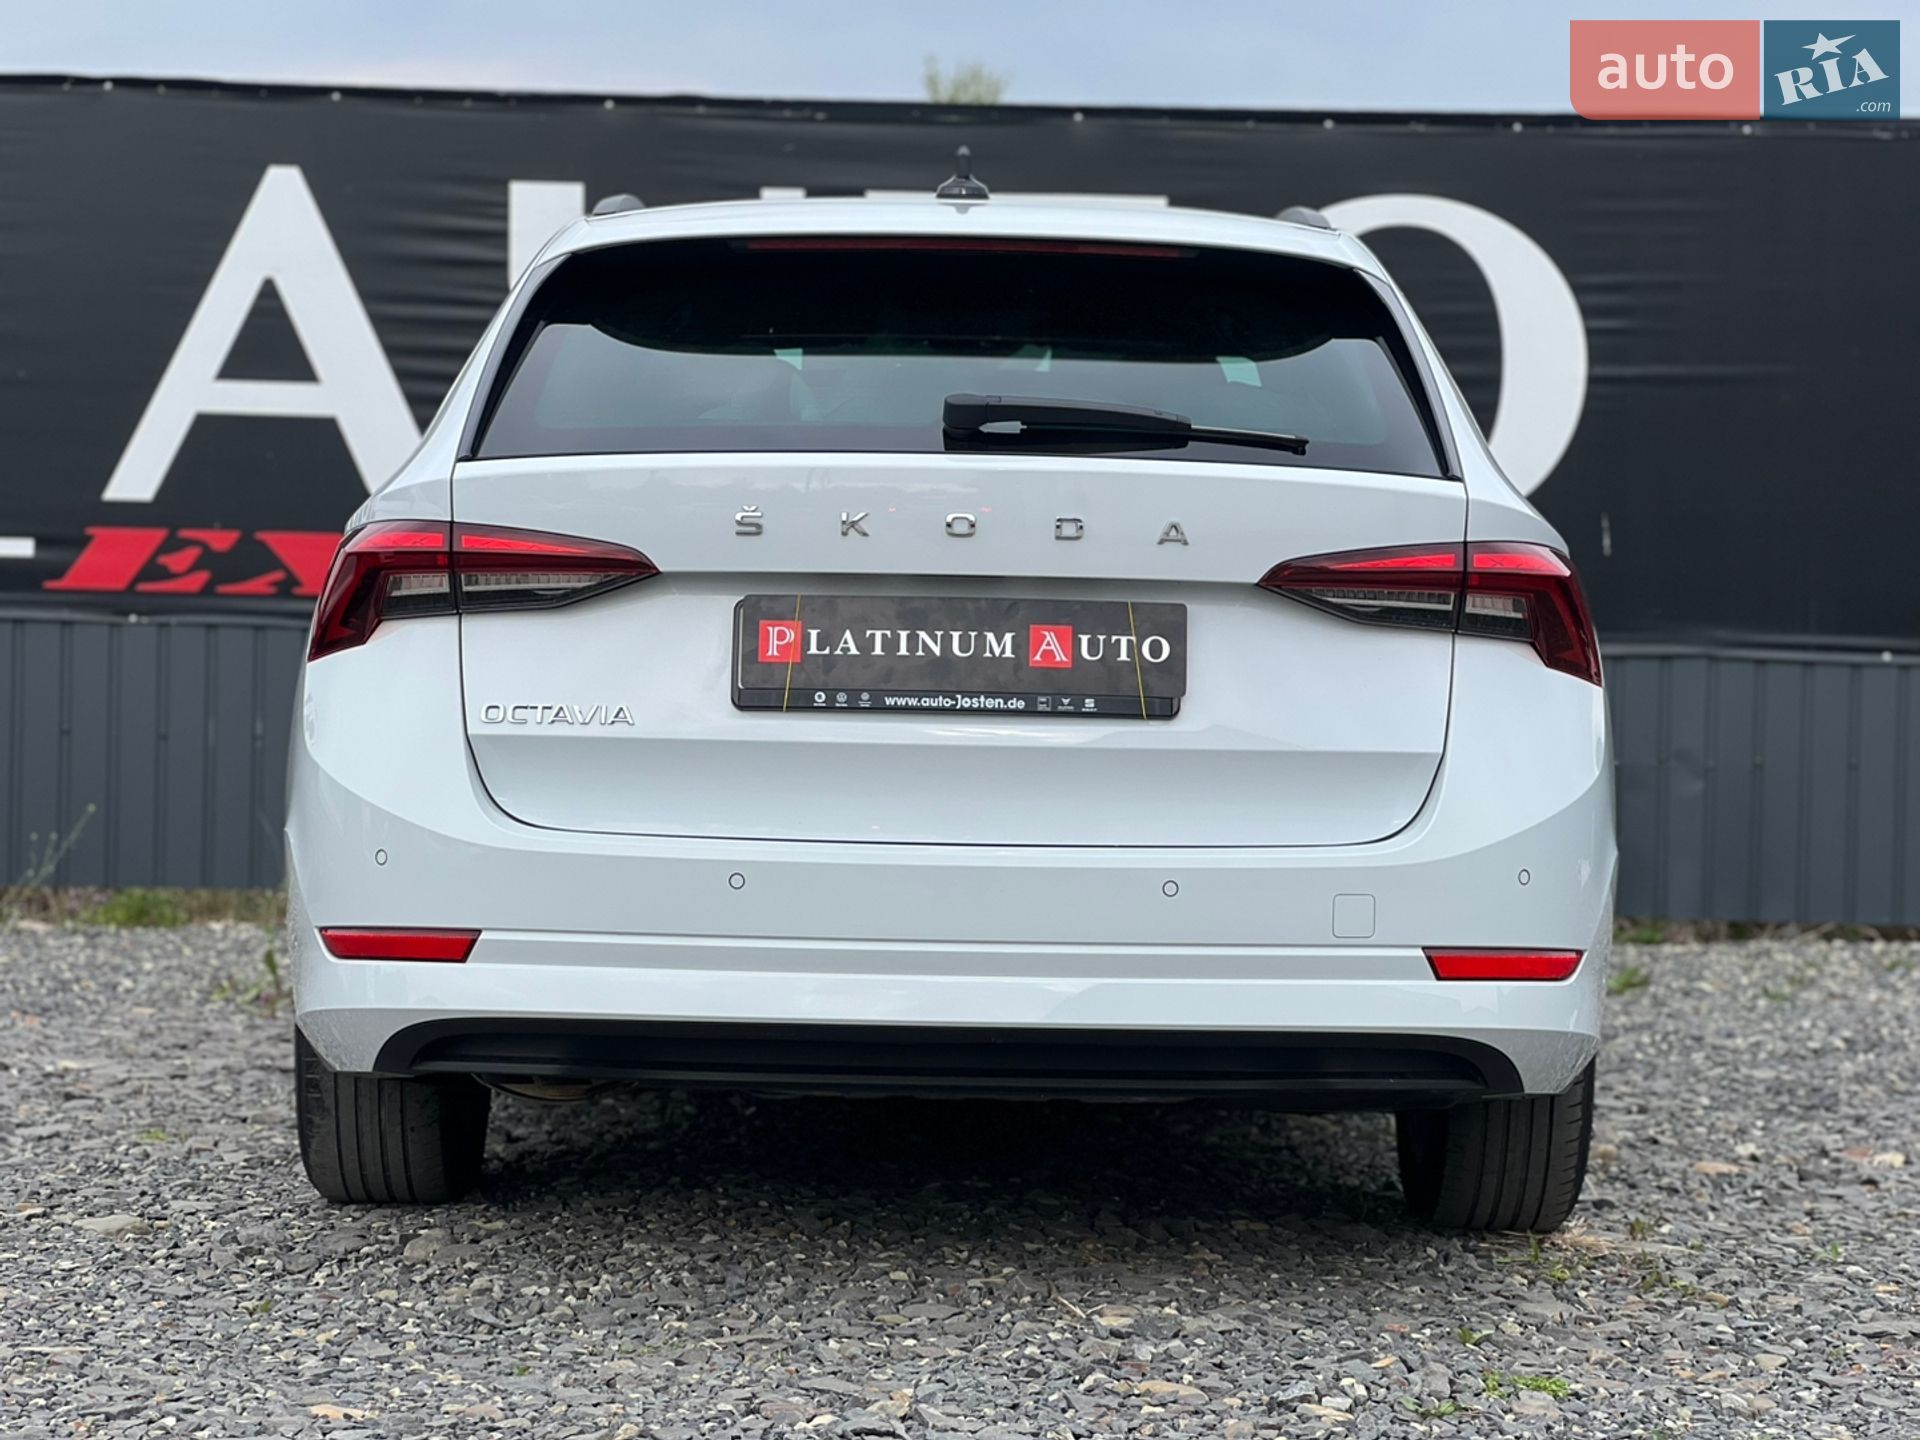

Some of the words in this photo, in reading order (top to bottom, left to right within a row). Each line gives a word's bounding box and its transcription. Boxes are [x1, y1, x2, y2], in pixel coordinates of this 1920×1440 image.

[734, 505, 1190, 546] ŠKODA
[764, 624, 1016, 661] PLATINUM
[1032, 628, 1171, 663] AUTO
[480, 704, 635, 726] OCTAVIA
